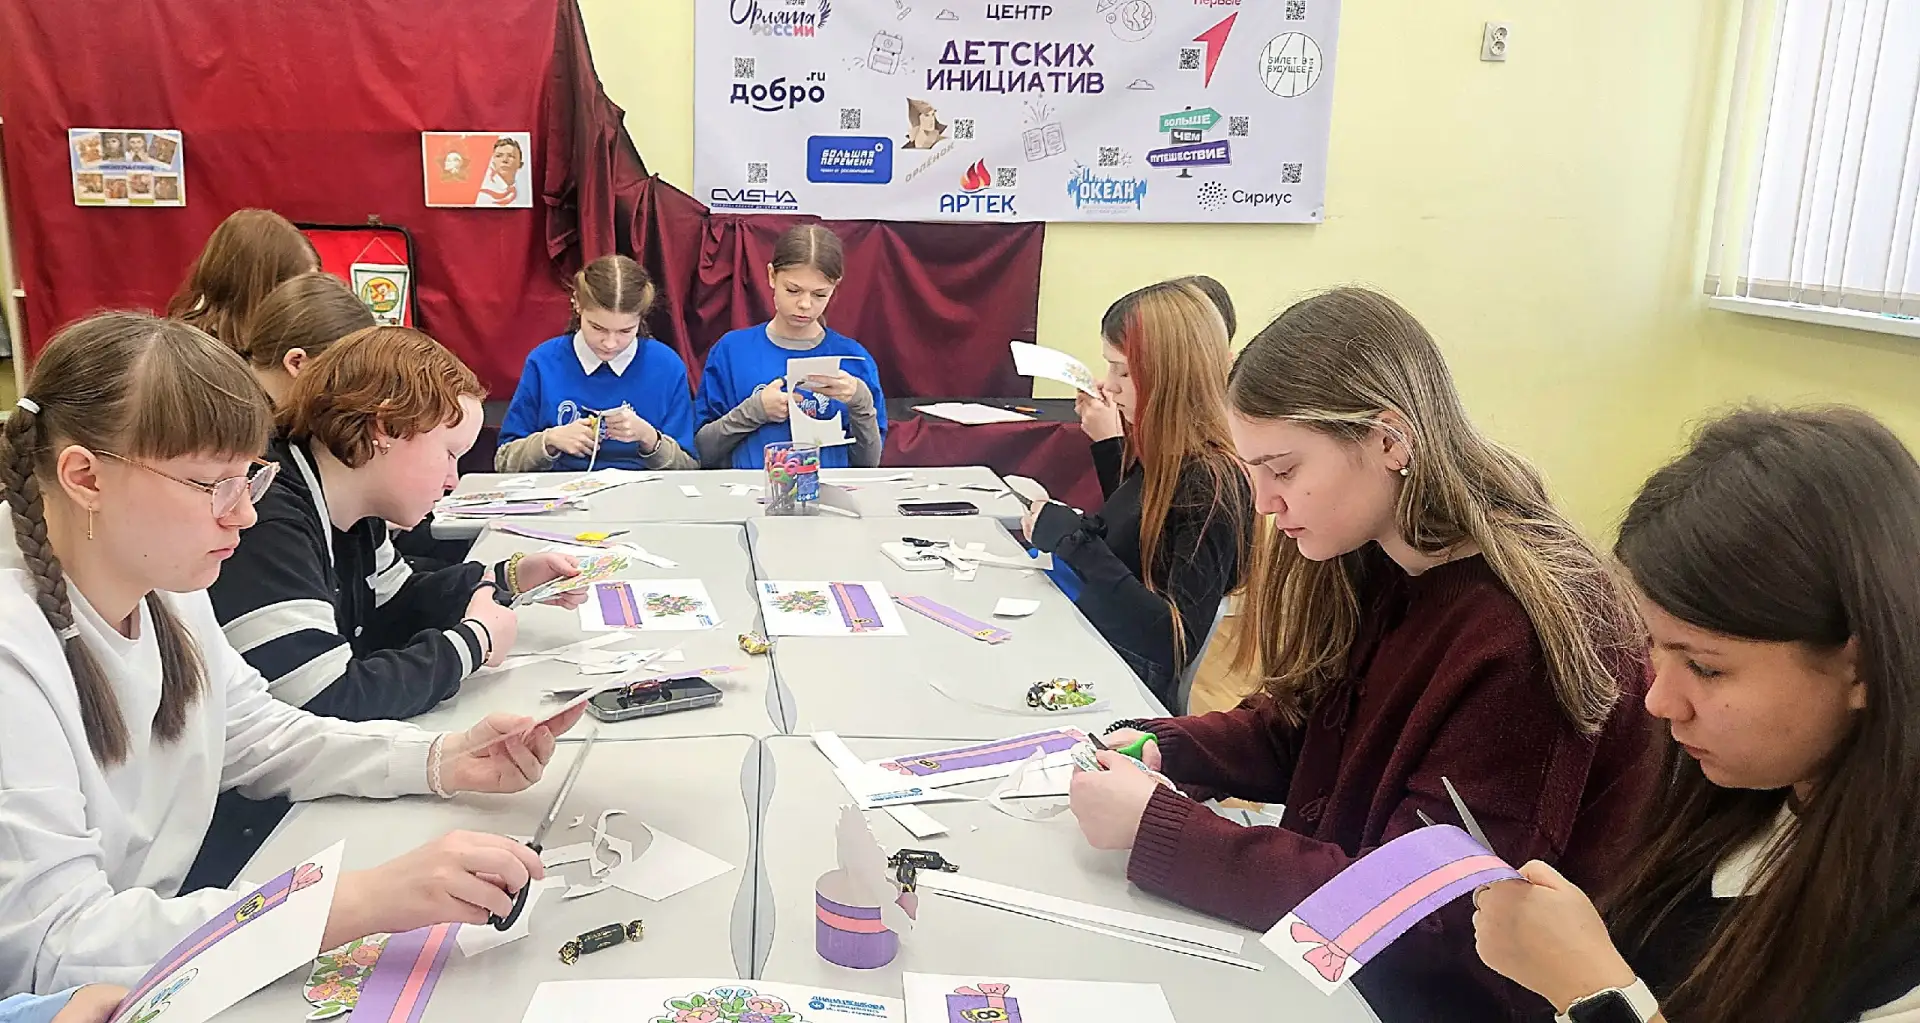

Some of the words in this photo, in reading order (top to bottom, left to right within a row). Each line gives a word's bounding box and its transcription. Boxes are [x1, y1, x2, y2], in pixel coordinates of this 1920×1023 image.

[986, 4, 1053, 20] ЦЕНТР
[752, 24, 814, 37] РОССИИ
[938, 40, 1095, 68] ДЕТСКИХ
[1267, 56, 1298, 65] БИЛЕТ
[1302, 56, 1307, 65] В
[806, 71, 826, 81] .ru
[1267, 65, 1306, 74] БУДУЩЕЕ
[926, 69, 1105, 94] ИНИЦИАТИВ
[730, 77, 825, 109] добро
[1164, 114, 1211, 127] БОЛЬШЕ
[1173, 131, 1200, 141] ЧЕМ
[822, 149, 875, 158] БОЛЬШАЯ
[1150, 147, 1226, 162] ПУТЕШЕСТВИЕ
[820, 158, 873, 166] ПЕРЕМЕНА
[711, 188, 798, 204] СМЕНА
[1080, 182, 1135, 199] ОКЕАН
[940, 194, 1016, 213] АРТЕК
[1232, 190, 1292, 207] Сириус
